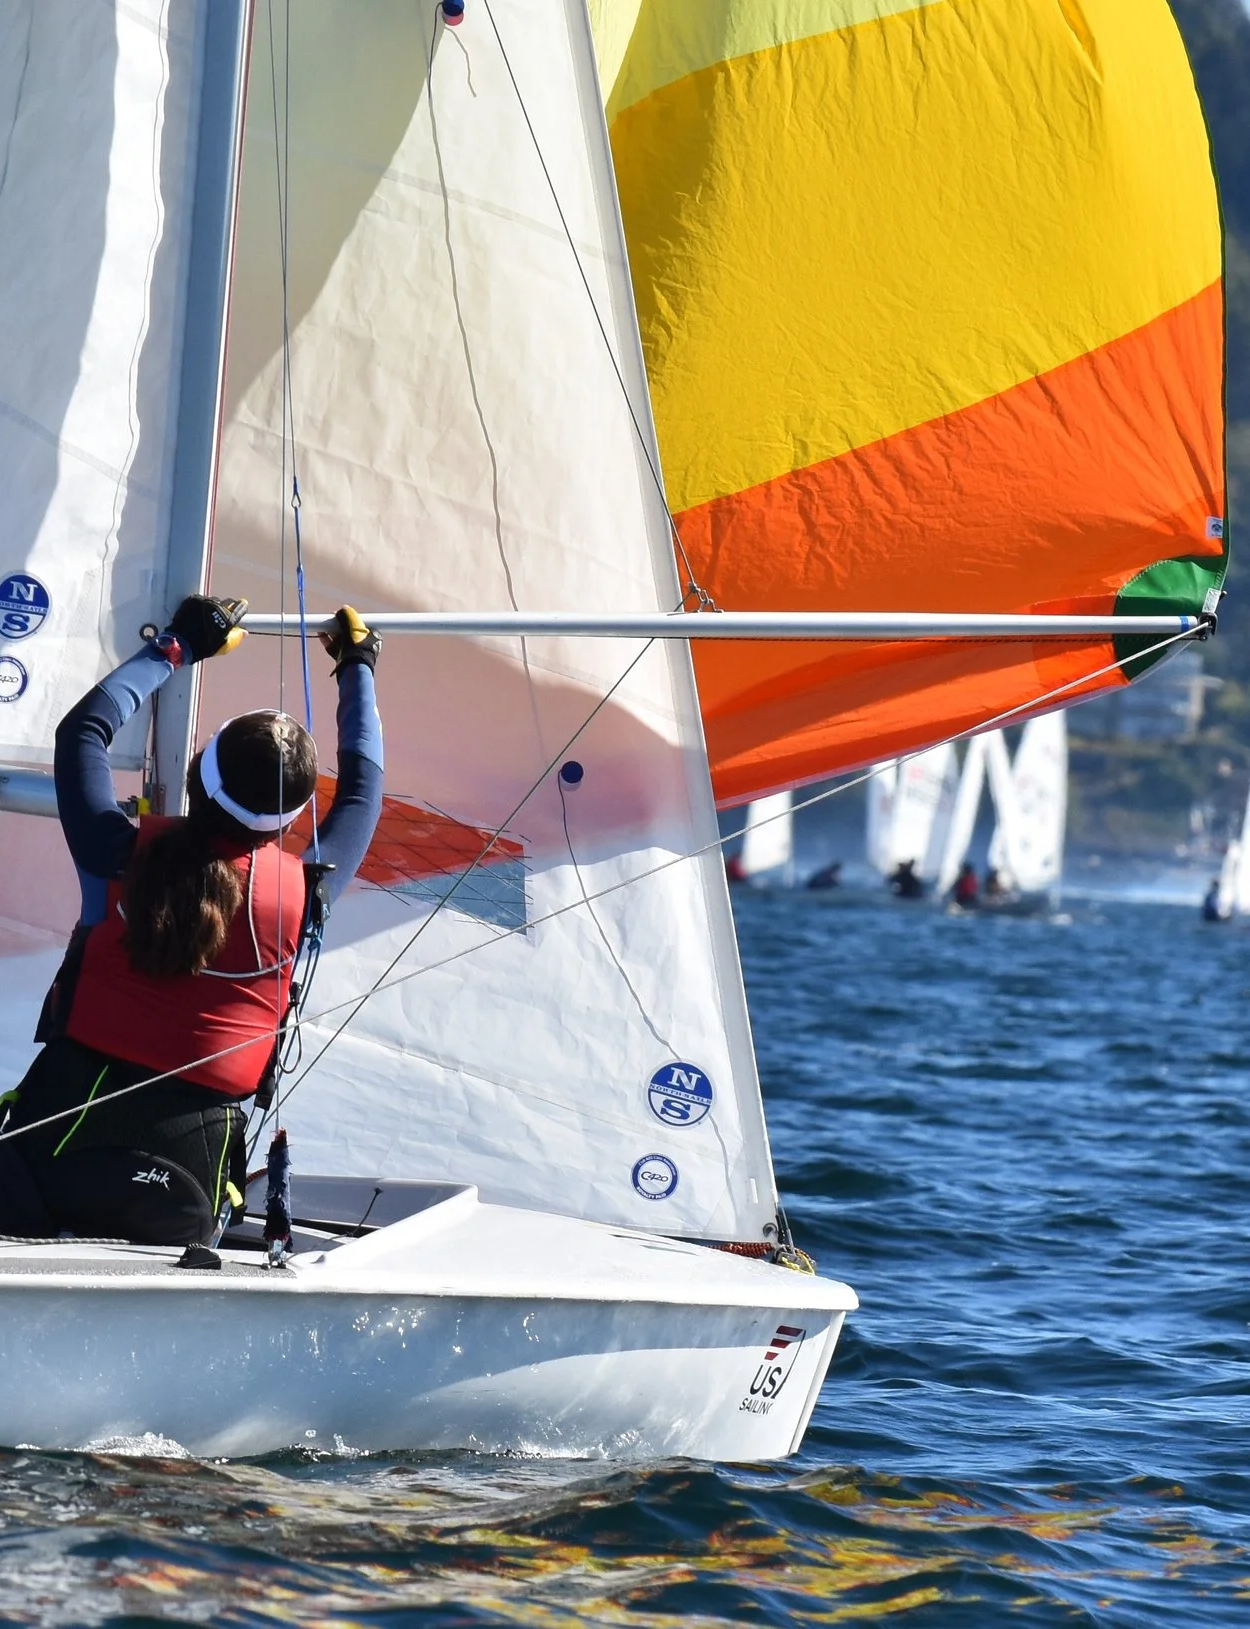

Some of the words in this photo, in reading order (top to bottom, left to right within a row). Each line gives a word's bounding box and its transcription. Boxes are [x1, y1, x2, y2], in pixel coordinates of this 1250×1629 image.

[8, 581, 38, 602] N
[2, 613, 30, 632] S
[667, 1067, 701, 1090] N
[660, 1099, 691, 1120] S
[641, 1171, 669, 1182] C420
